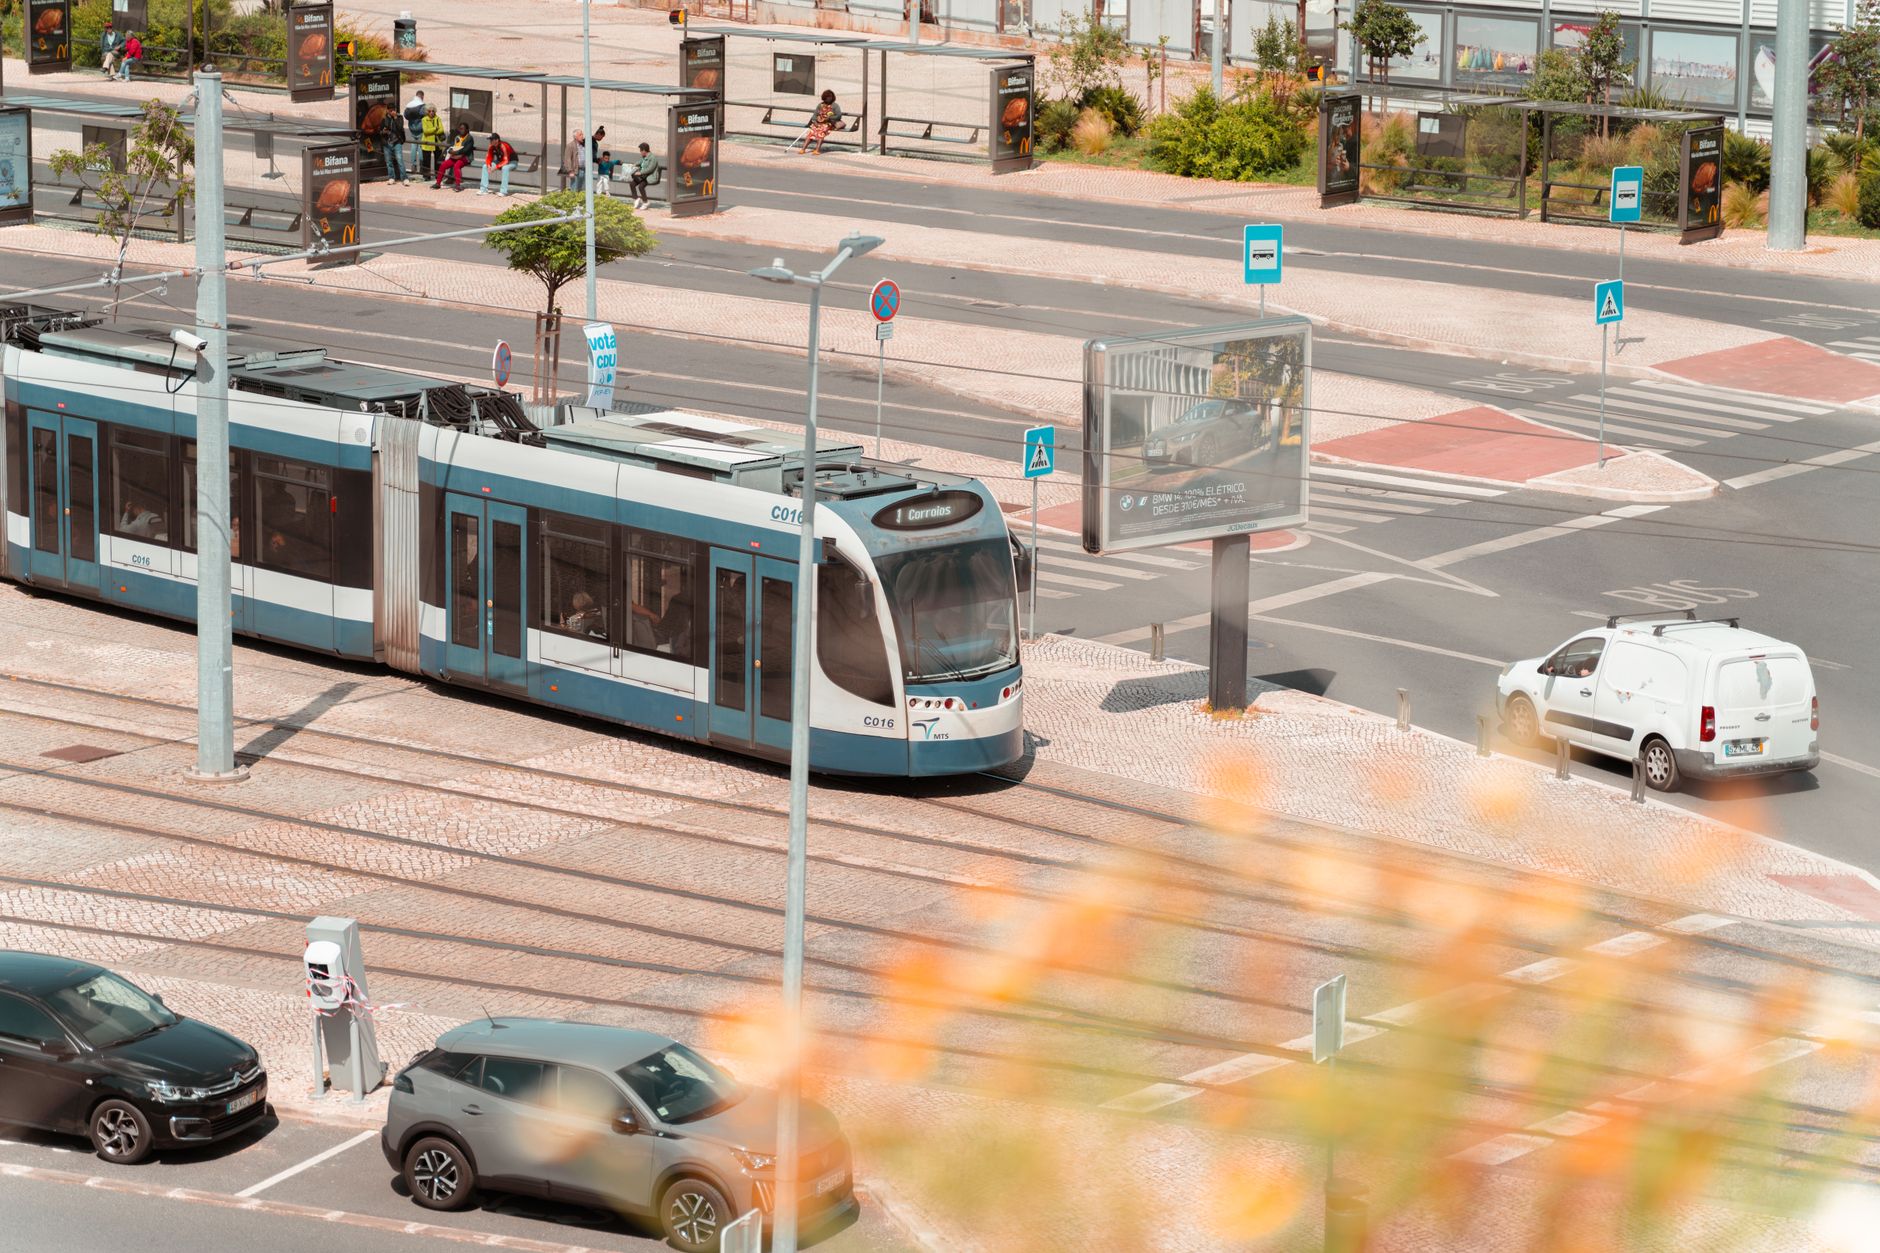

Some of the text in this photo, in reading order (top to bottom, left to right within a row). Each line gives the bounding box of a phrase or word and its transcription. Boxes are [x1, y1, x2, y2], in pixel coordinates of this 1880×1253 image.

[588, 333, 616, 351] vota
[597, 354, 616, 369] CDU
[1152, 493, 1173, 504] BMW
[895, 505, 951, 524] 1 Corroios
[1152, 503, 1180, 516] DESDE
[132, 554, 150, 566] C016
[1600, 579, 1760, 611] BUS
[864, 716, 895, 728] C016
